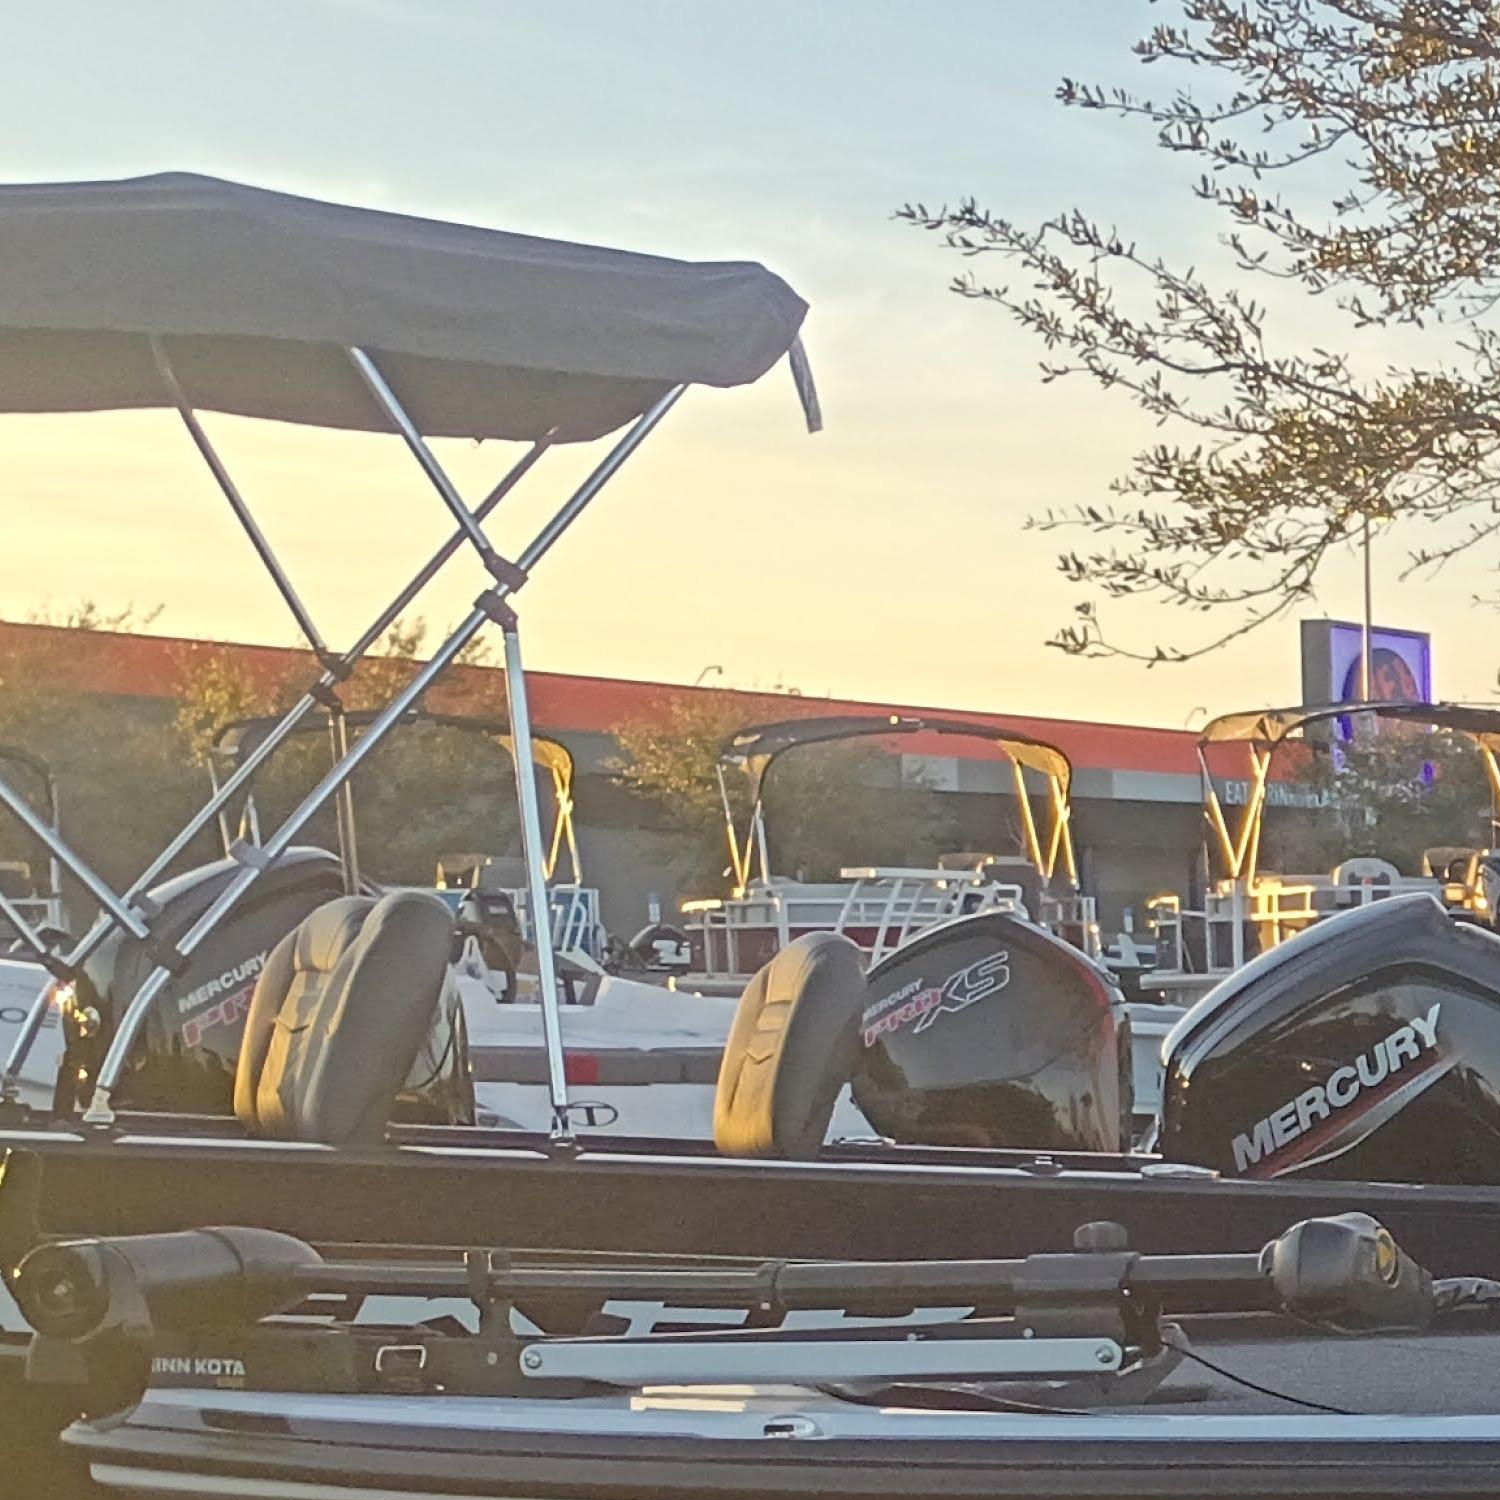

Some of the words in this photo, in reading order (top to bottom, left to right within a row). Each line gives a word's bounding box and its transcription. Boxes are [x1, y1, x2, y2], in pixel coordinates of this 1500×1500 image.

[1225, 781, 1248, 805] EAT
[178, 951, 269, 1012] MERCURY
[181, 983, 258, 1047] PR
[1231, 1003, 1441, 1172] MERCURY
[194, 1358, 246, 1377] KOTA
